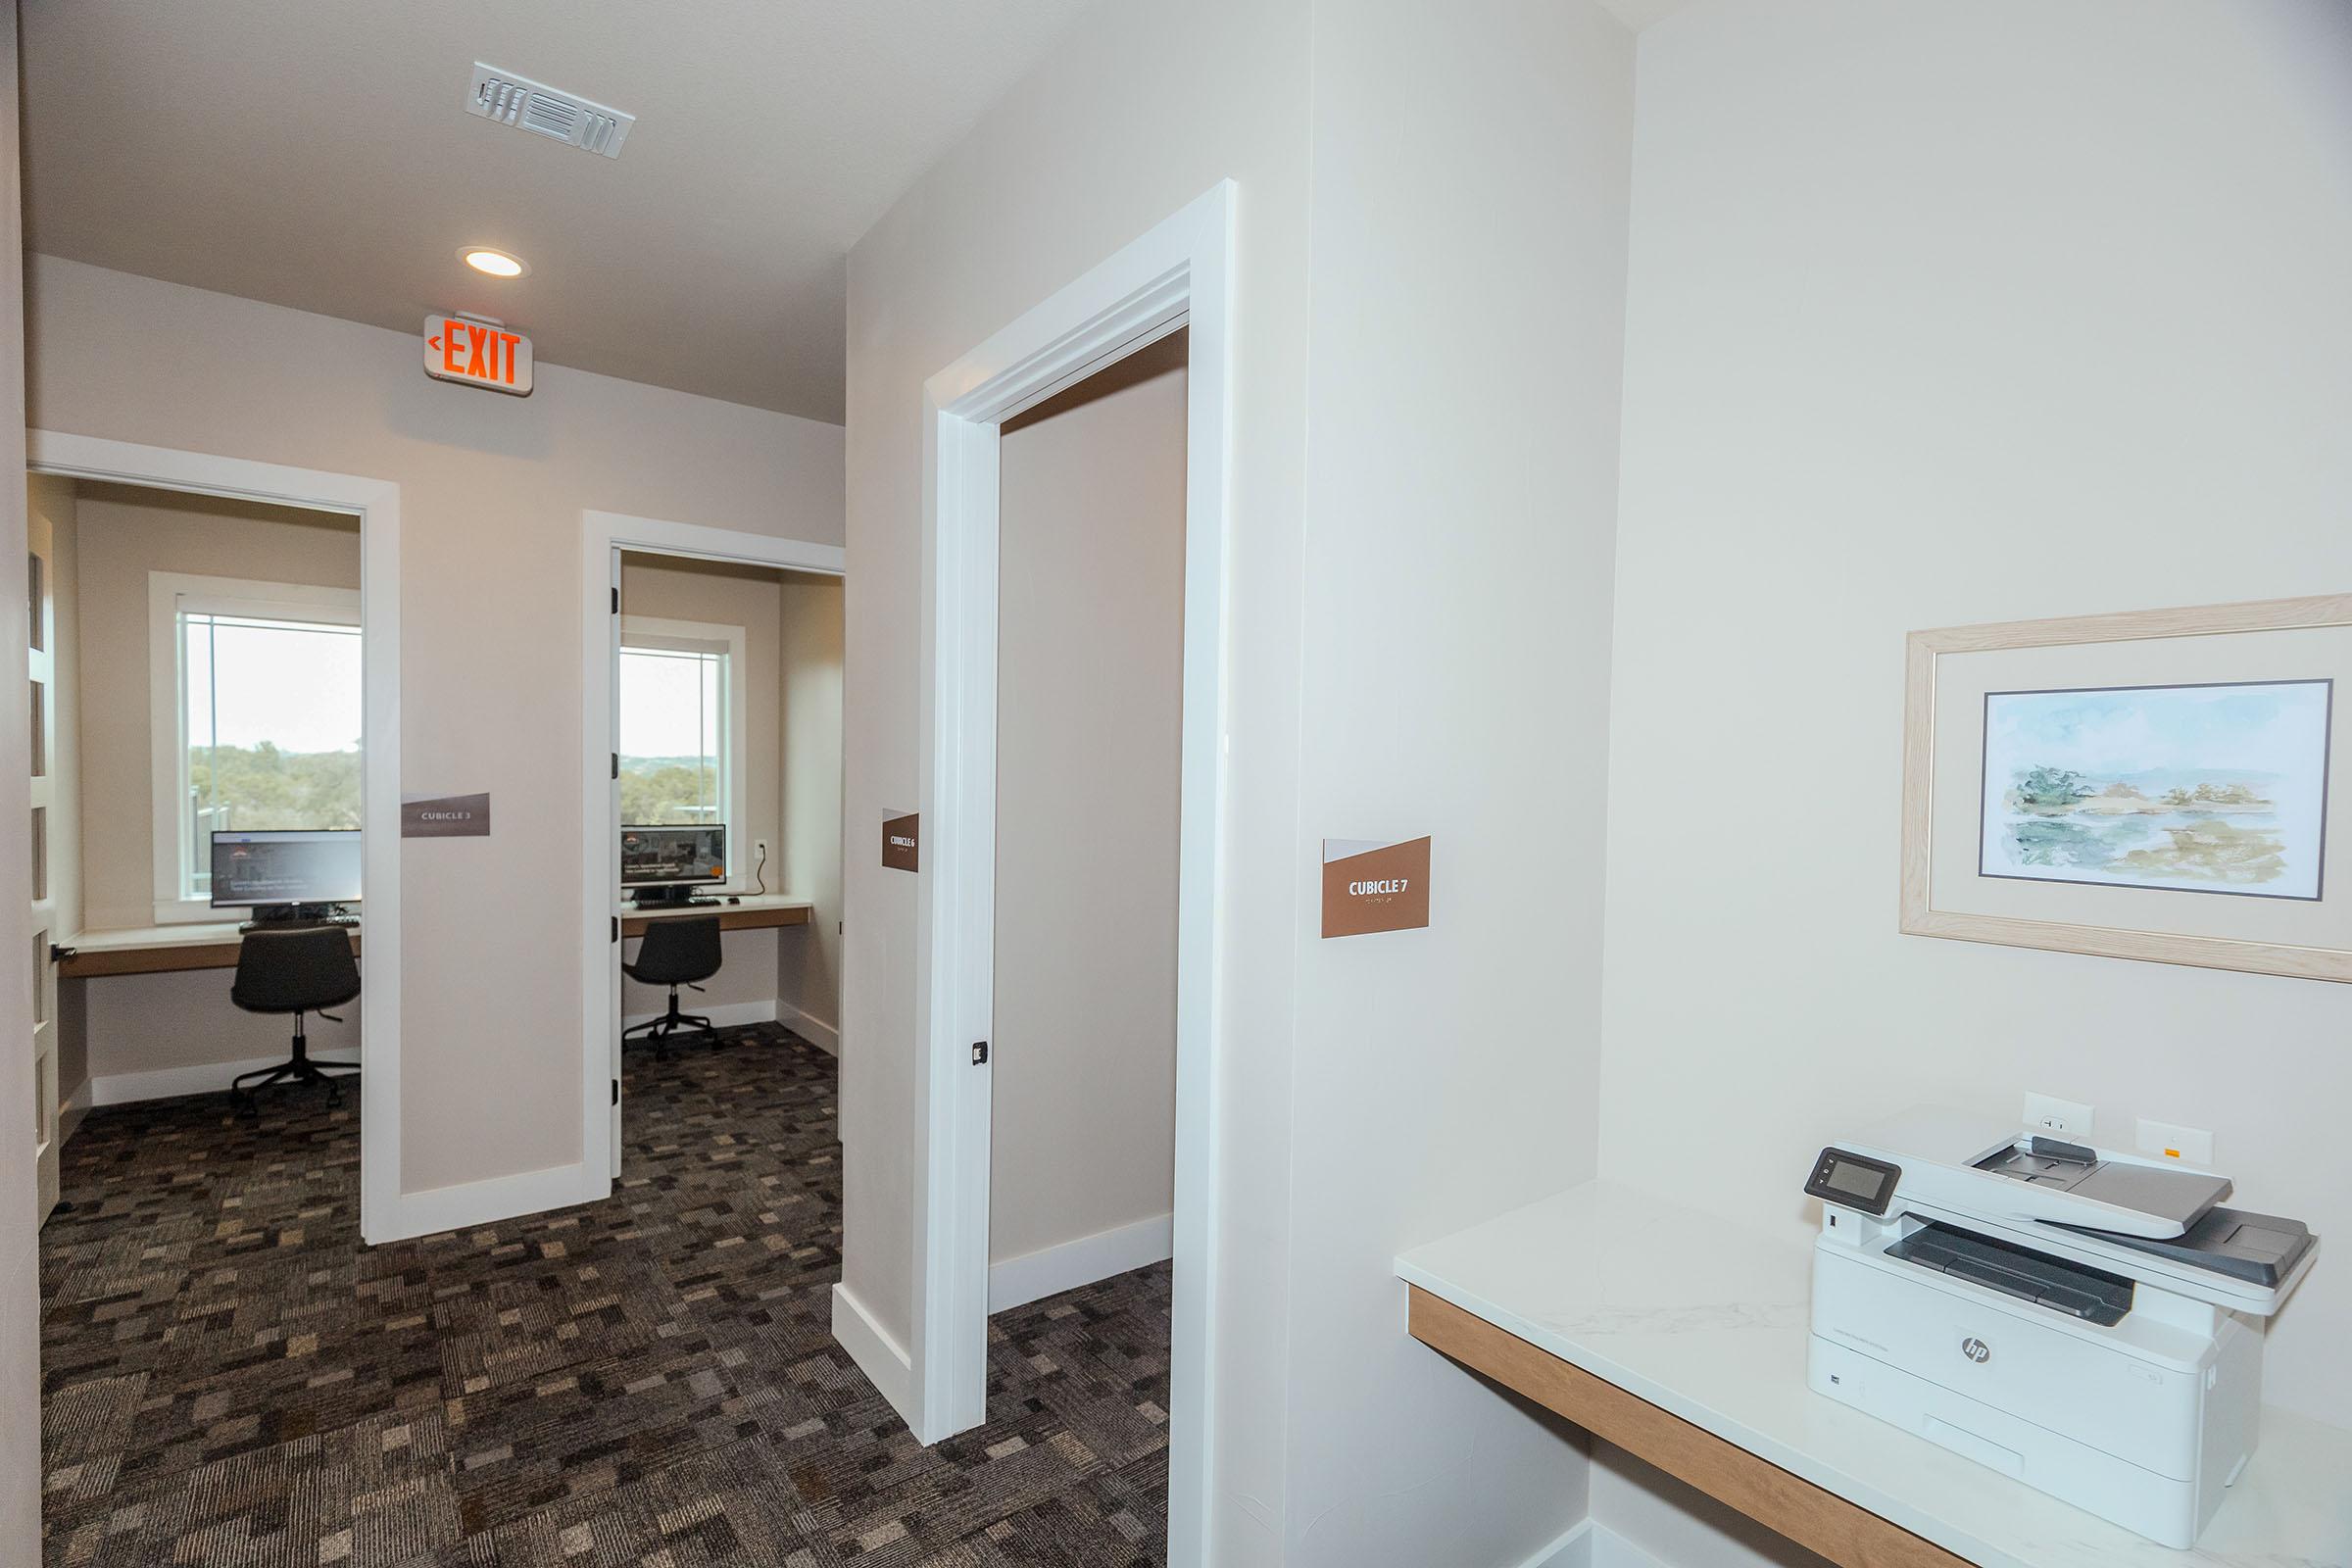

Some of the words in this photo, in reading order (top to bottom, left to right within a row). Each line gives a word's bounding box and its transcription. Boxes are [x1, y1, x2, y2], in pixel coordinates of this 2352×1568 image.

[444, 319, 520, 384] EXIT
[910, 839, 915, 848] 6
[1349, 879, 1398, 896] CUBICLE
[1400, 879, 1408, 893] 7
[1963, 1338, 1989, 1363] hp
